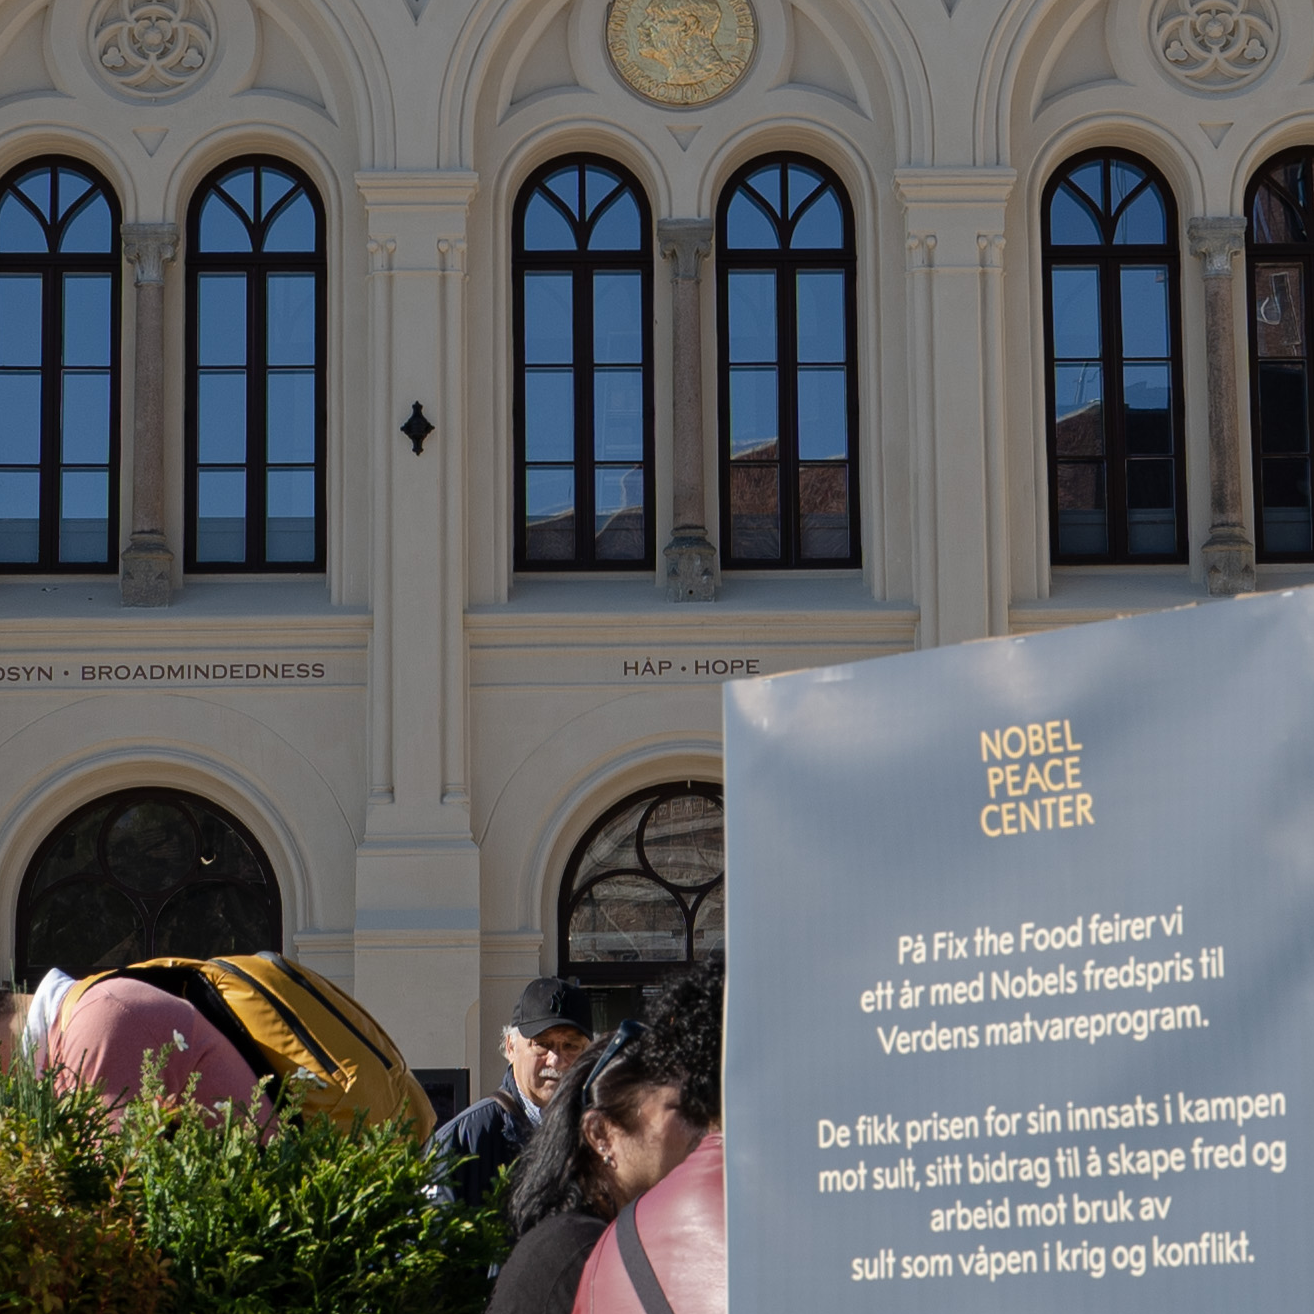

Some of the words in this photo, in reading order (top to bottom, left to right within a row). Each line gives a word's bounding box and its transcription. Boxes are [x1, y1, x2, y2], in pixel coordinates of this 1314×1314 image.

[81, 663, 325, 681] BROADMINDEDNESS
[624, 657, 672, 675] HÅP
[695, 659, 760, 674] HOPE
[980, 719, 1083, 762] NOBEL
[987, 756, 1082, 798] PEACE
[980, 793, 1095, 837] CENTER
[898, 934, 926, 964] På
[933, 931, 968, 961] Fix
[974, 927, 1014, 957] the
[1020, 917, 1083, 952] Food
[1089, 914, 1156, 944] feirer
[1160, 905, 1184, 936] vi
[861, 981, 894, 1012] ett
[899, 979, 925, 1009] år
[931, 972, 983, 1005] med
[991, 965, 1077, 1001] Nobels
[1083, 952, 1193, 992] fredspris
[1198, 946, 1224, 978] til
[878, 1021, 979, 1054] Verdens
[986, 1004, 1209, 1044] matvareprogram.
[818, 1120, 850, 1148] De
[856, 1116, 900, 1145] fikk
[906, 1112, 979, 1149] prisen
[985, 1106, 1022, 1137] for
[1027, 1105, 1062, 1134] sin
[1067, 1096, 1159, 1132] innsats
[1164, 1094, 1172, 1124] i
[1179, 1092, 1286, 1131] kampen
[819, 1162, 867, 1192] mot
[872, 1158, 921, 1191] sult,
[926, 1155, 962, 1187] sitt
[968, 1152, 1050, 1188] bidrag
[1056, 1147, 1080, 1179] til
[1087, 1147, 1102, 1177] å
[1108, 1143, 1185, 1180] skape
[1191, 1136, 1245, 1170] fred
[1253, 1140, 1286, 1173] og
[930, 1198, 1009, 1232] arbeid
[1017, 1195, 1066, 1226] mot
[1073, 1191, 1134, 1224] bruk
[1139, 1197, 1171, 1221] av
[852, 1249, 895, 1281] sult
[901, 1252, 953, 1278] som
[959, 1245, 1037, 1282] våpen
[1043, 1242, 1050, 1272] i
[1056, 1241, 1106, 1278] krig
[1112, 1244, 1147, 1276] og
[1153, 1231, 1255, 1267] konflikt.
